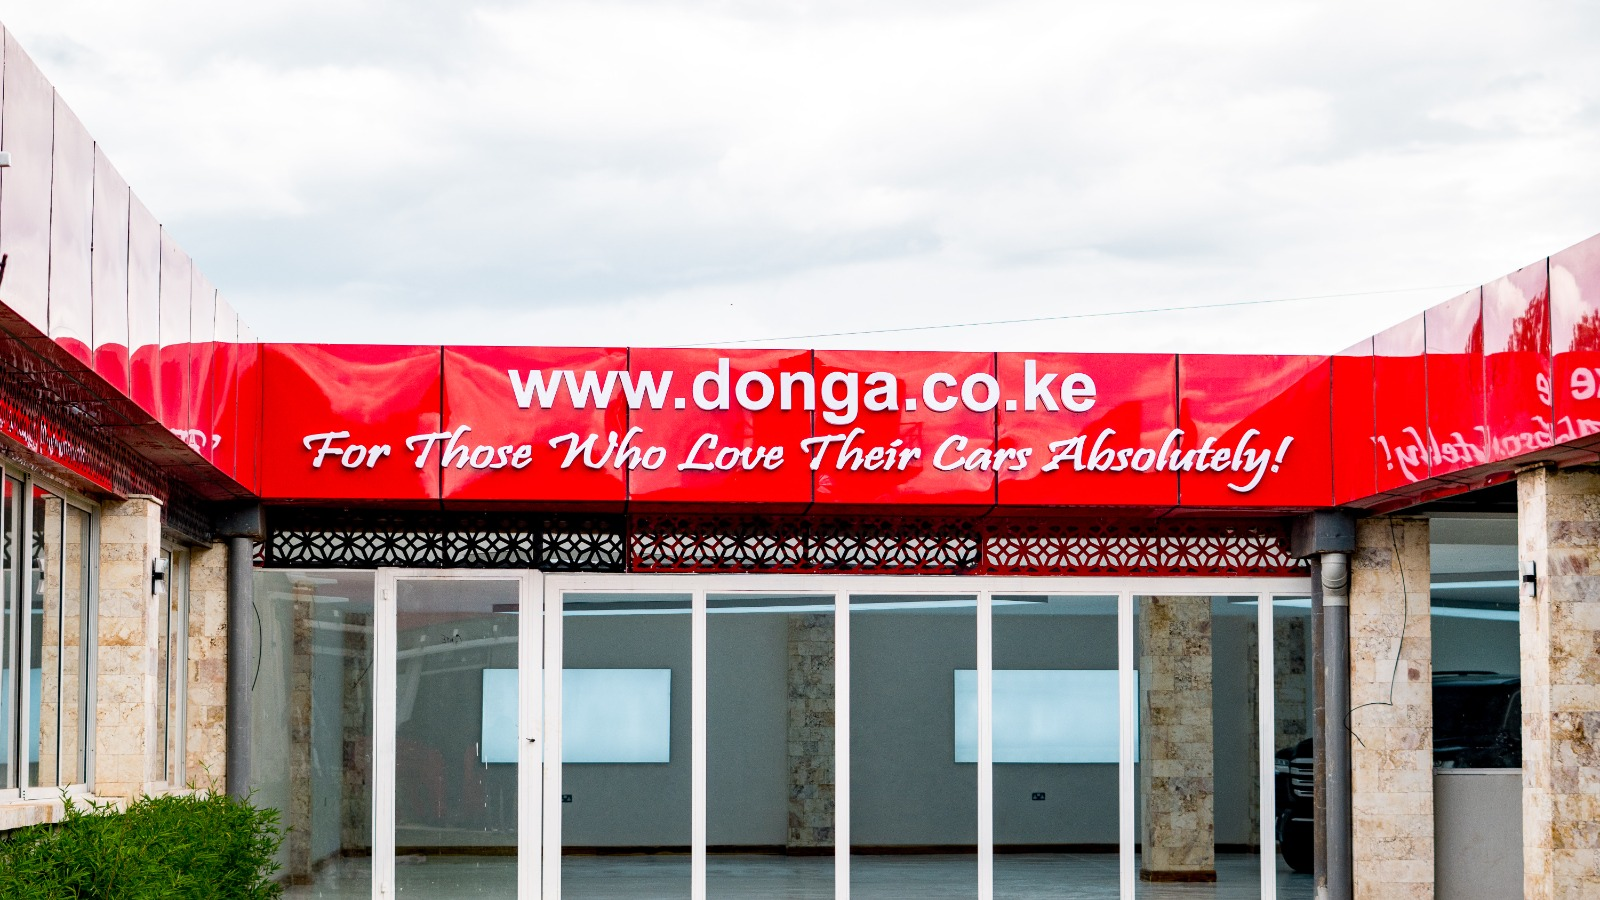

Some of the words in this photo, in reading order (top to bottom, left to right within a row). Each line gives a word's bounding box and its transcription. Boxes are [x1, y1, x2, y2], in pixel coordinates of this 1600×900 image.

[508, 357, 1097, 425] www.donga.co.ke
[303, 430, 391, 469] For
[406, 424, 533, 470] Those
[549, 425, 667, 471] Who
[677, 433, 784, 472] Love
[800, 427, 922, 472] Their
[933, 434, 1033, 472] Cars
[1041, 427, 1295, 492] Absolutely!
